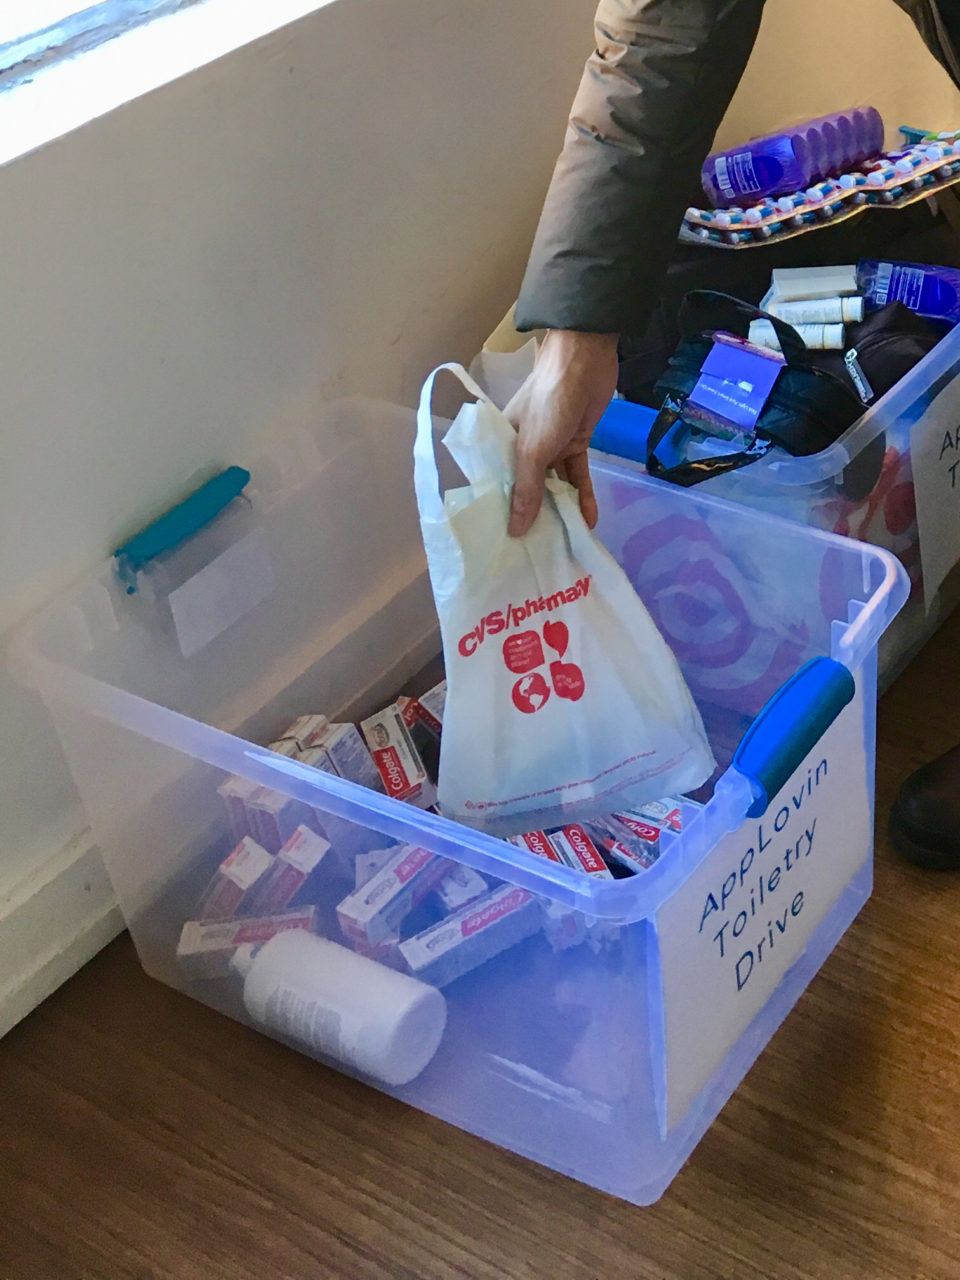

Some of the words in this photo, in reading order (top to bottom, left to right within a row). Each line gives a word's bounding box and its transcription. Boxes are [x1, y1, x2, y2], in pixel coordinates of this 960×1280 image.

[381, 751, 404, 791] Colgate
[568, 828, 599, 869] Colgate
[713, 818, 817, 958] Toiletry
[735, 891, 804, 991] Drive
